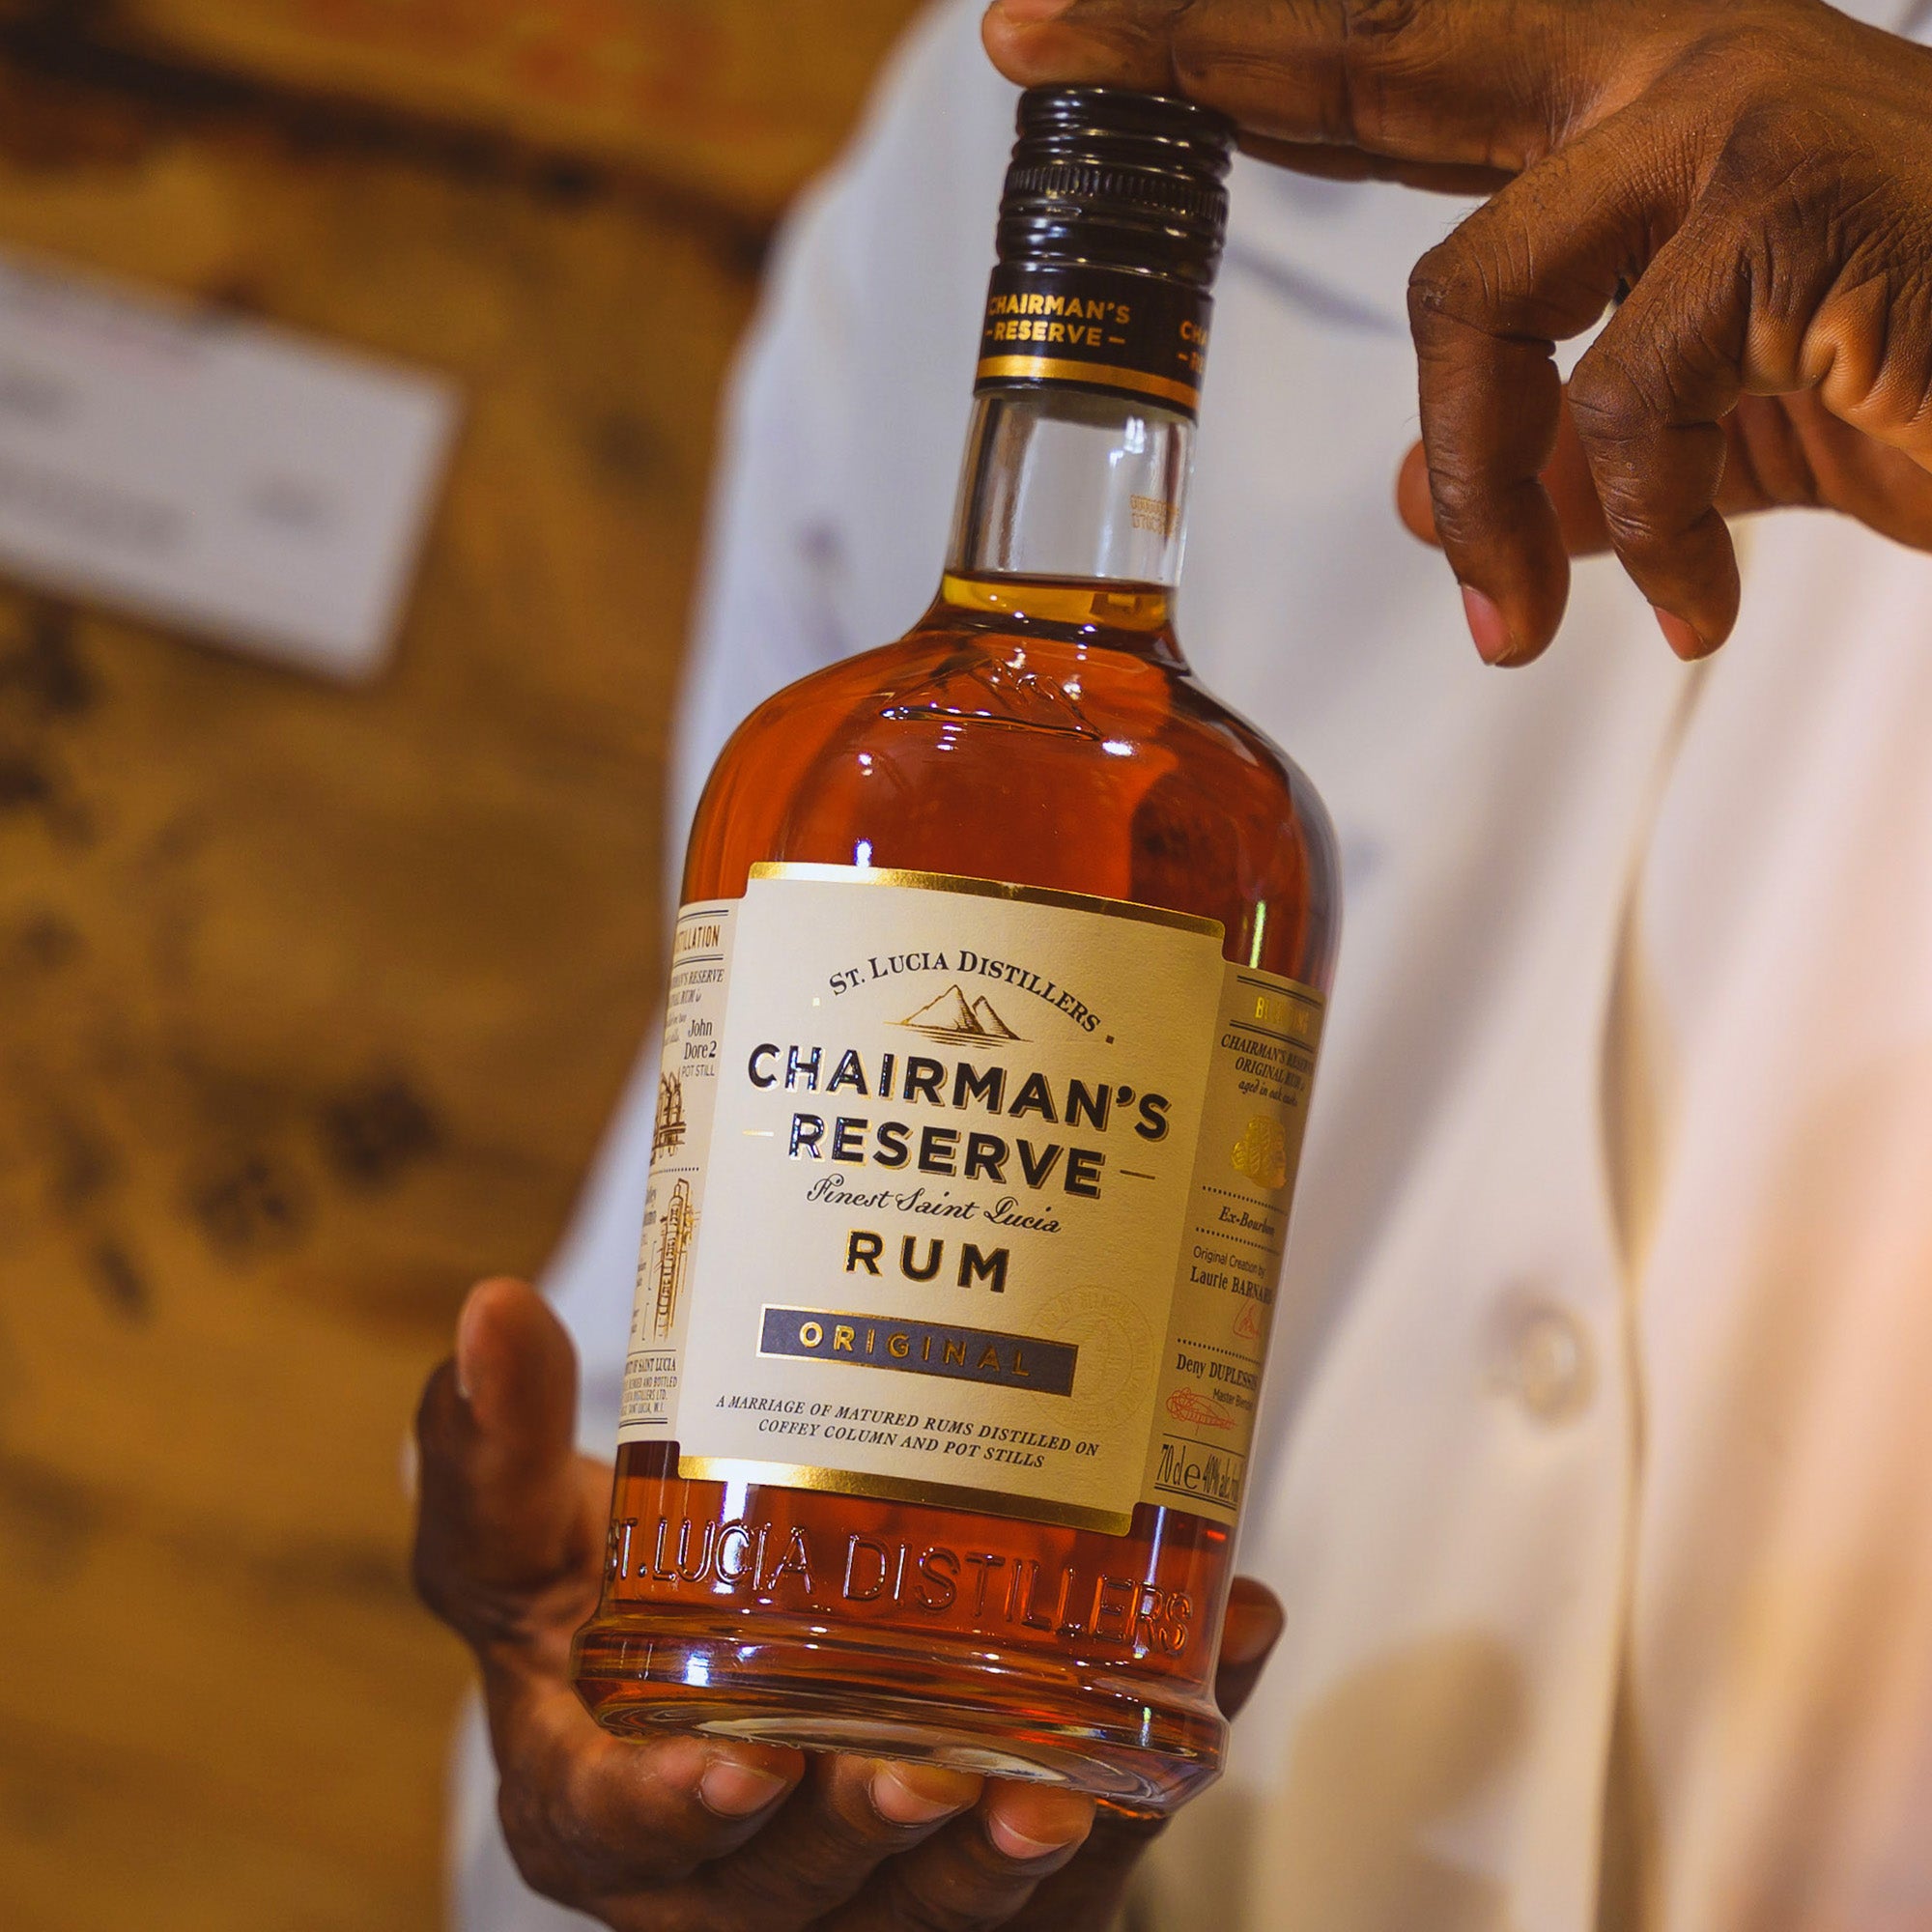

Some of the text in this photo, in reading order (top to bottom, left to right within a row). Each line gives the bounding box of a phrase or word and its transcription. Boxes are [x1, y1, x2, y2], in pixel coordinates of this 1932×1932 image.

[988, 293, 1130, 325] CHAIRMAN'S
[994, 320, 1102, 347] RESERVE
[689, 969, 724, 984] RESERVE
[828, 950, 1102, 1034] ST. LUCIA DISTILLERS
[688, 1019, 713, 1037] John
[1221, 1034, 1287, 1065] CHAIRMAN'S
[681, 1065, 716, 1078] POT STILL
[1235, 1057, 1286, 1086] ORIGINAL
[747, 1042, 1173, 1145] CHAIRMAN'S
[1238, 1079, 1260, 1094] aged
[1261, 1082, 1269, 1096] in
[787, 1111, 1107, 1199] RESERVE
[807, 1173, 1062, 1235] Finest Saint Lucia
[842, 1228, 1010, 1293] RUM
[1193, 1245, 1228, 1264] Original
[1190, 1265, 1229, 1291] Laurie
[655, 1357, 676, 1372] LUCIA
[799, 1321, 1031, 1378] ORIGINAL
[1176, 1353, 1208, 1378] Deny
[653, 1376, 678, 1387] BOTTLED
[715, 1395, 1100, 1458] A MARRIAGE OF MATURED RUMS DISTILLED ON
[757, 1417, 1045, 1469] COFFEY COLUMN AND POT STILLS
[842, 1533, 1192, 1657] DISTILLERS
